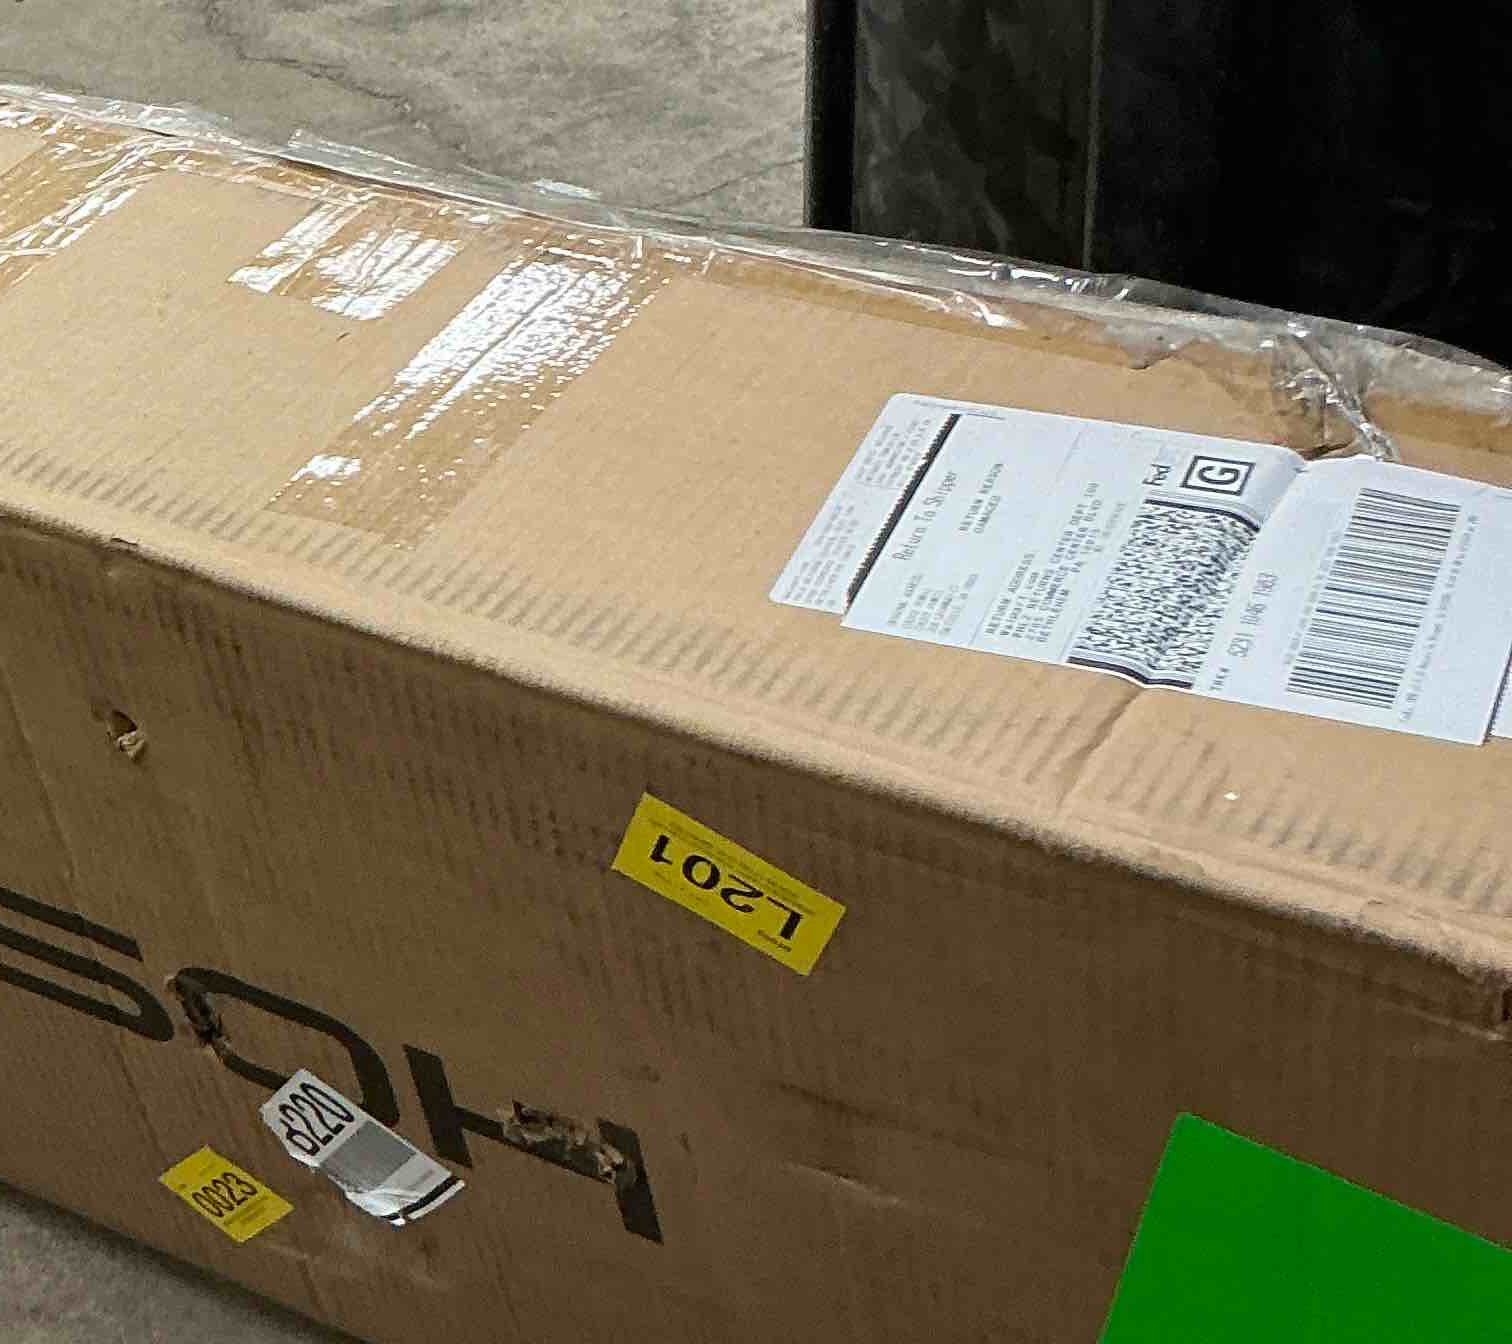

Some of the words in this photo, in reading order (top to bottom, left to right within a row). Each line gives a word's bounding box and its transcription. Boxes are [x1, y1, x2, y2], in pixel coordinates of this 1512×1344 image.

[1197, 465, 1240, 486] G
[891, 526, 927, 561] Return
[913, 509, 937, 523] To
[645, 831, 807, 943] L201
[189, 1169, 262, 1221] 0023
